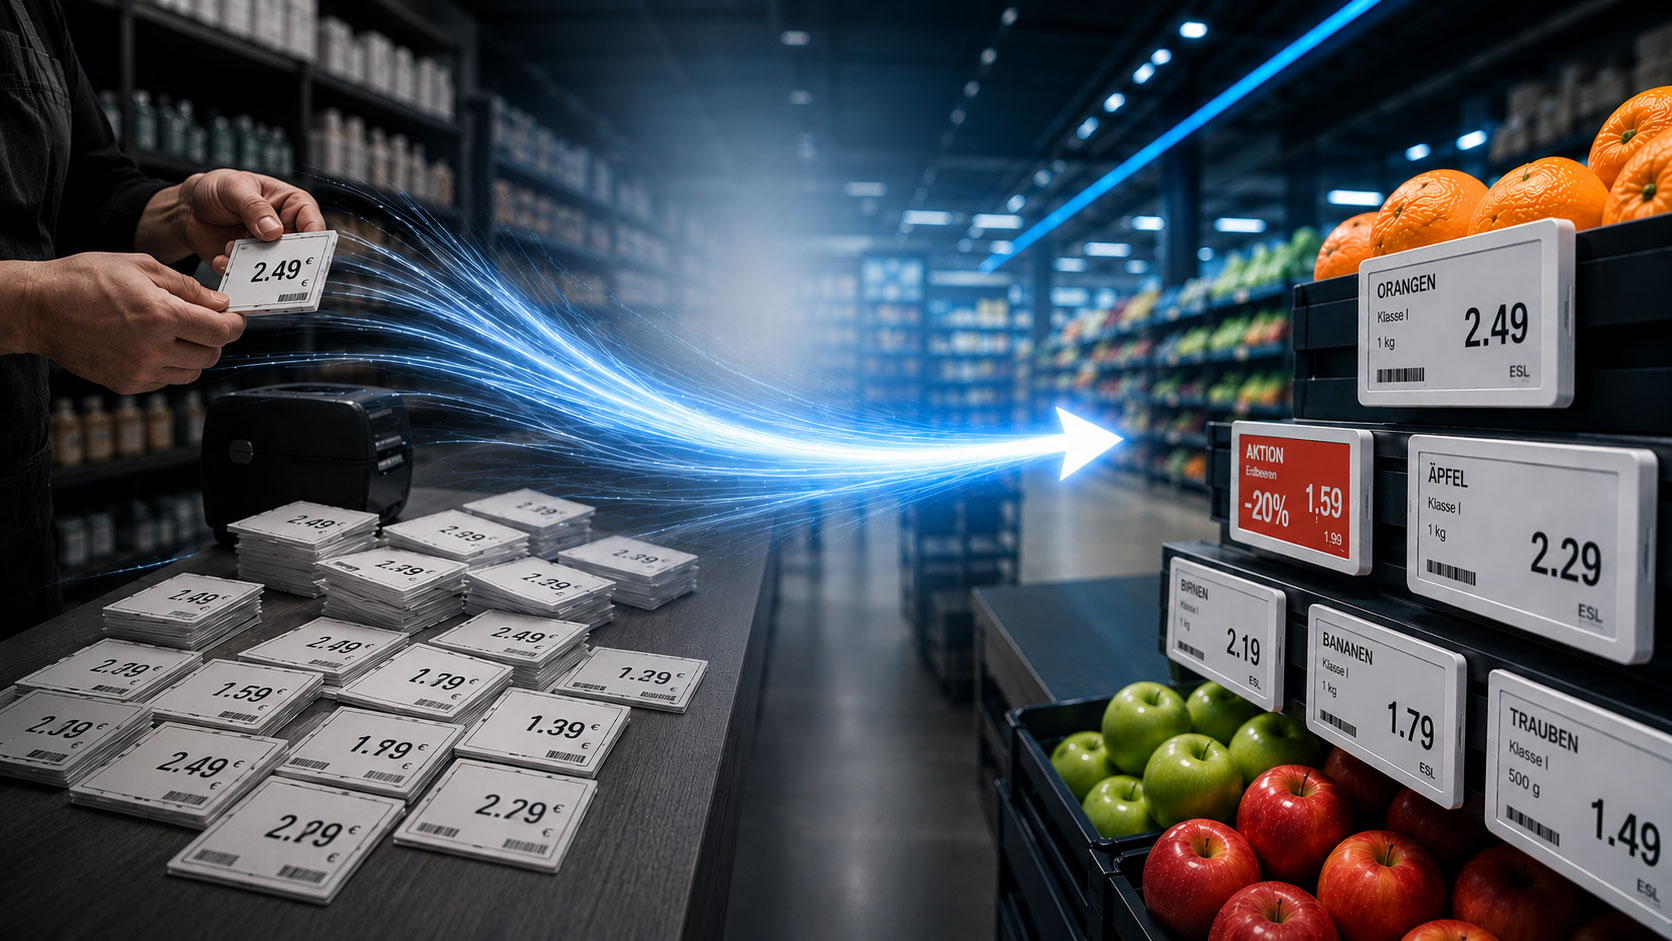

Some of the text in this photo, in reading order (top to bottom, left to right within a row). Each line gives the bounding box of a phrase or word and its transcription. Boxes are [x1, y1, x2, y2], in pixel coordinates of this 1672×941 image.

[251, 260, 301, 282] 2.49
[1378, 274, 1435, 298] ORANGEN
[1378, 311, 1403, 323] Klasse
[1465, 302, 1528, 347] 2.49
[1385, 337, 1394, 350] kg
[1510, 365, 1530, 377] ESL
[1246, 444, 1283, 463] AKTION
[1429, 462, 1468, 488] ÄPFEL
[1245, 490, 1288, 527] -20%
[1305, 483, 1342, 518] 1.59
[1429, 497, 1455, 513] Klasse
[287, 515, 335, 529] 2.49
[1324, 531, 1342, 545] 1.99
[1436, 525, 1445, 542] kg
[1531, 532, 1601, 586] 2.29
[168, 590, 219, 604] 2.49
[1181, 579, 1208, 600] BIRNEN
[1578, 604, 1603, 623] ESL
[491, 627, 545, 643] 2.49
[306, 637, 362, 653] 2.49
[1227, 628, 1260, 665] 2.19
[1323, 632, 1374, 666] BANANEN
[1323, 658, 1344, 676] Klasse
[1249, 676, 1261, 689] ESL
[1328, 683, 1336, 698] kg
[213, 683, 272, 702] 1.59
[527, 716, 585, 738] 1.39
[1388, 701, 1434, 750] 1.79
[1510, 707, 1578, 754] TRAUBEN
[1510, 740, 1542, 767] Klasse
[156, 752, 228, 778] 2.49
[1420, 762, 1435, 779] ESL
[1509, 768, 1540, 798] 500 g
[553, 805, 564, 813] €
[349, 826, 360, 834] €
[1592, 799, 1660, 867] 1.49
[1637, 879, 1659, 902] ESL
